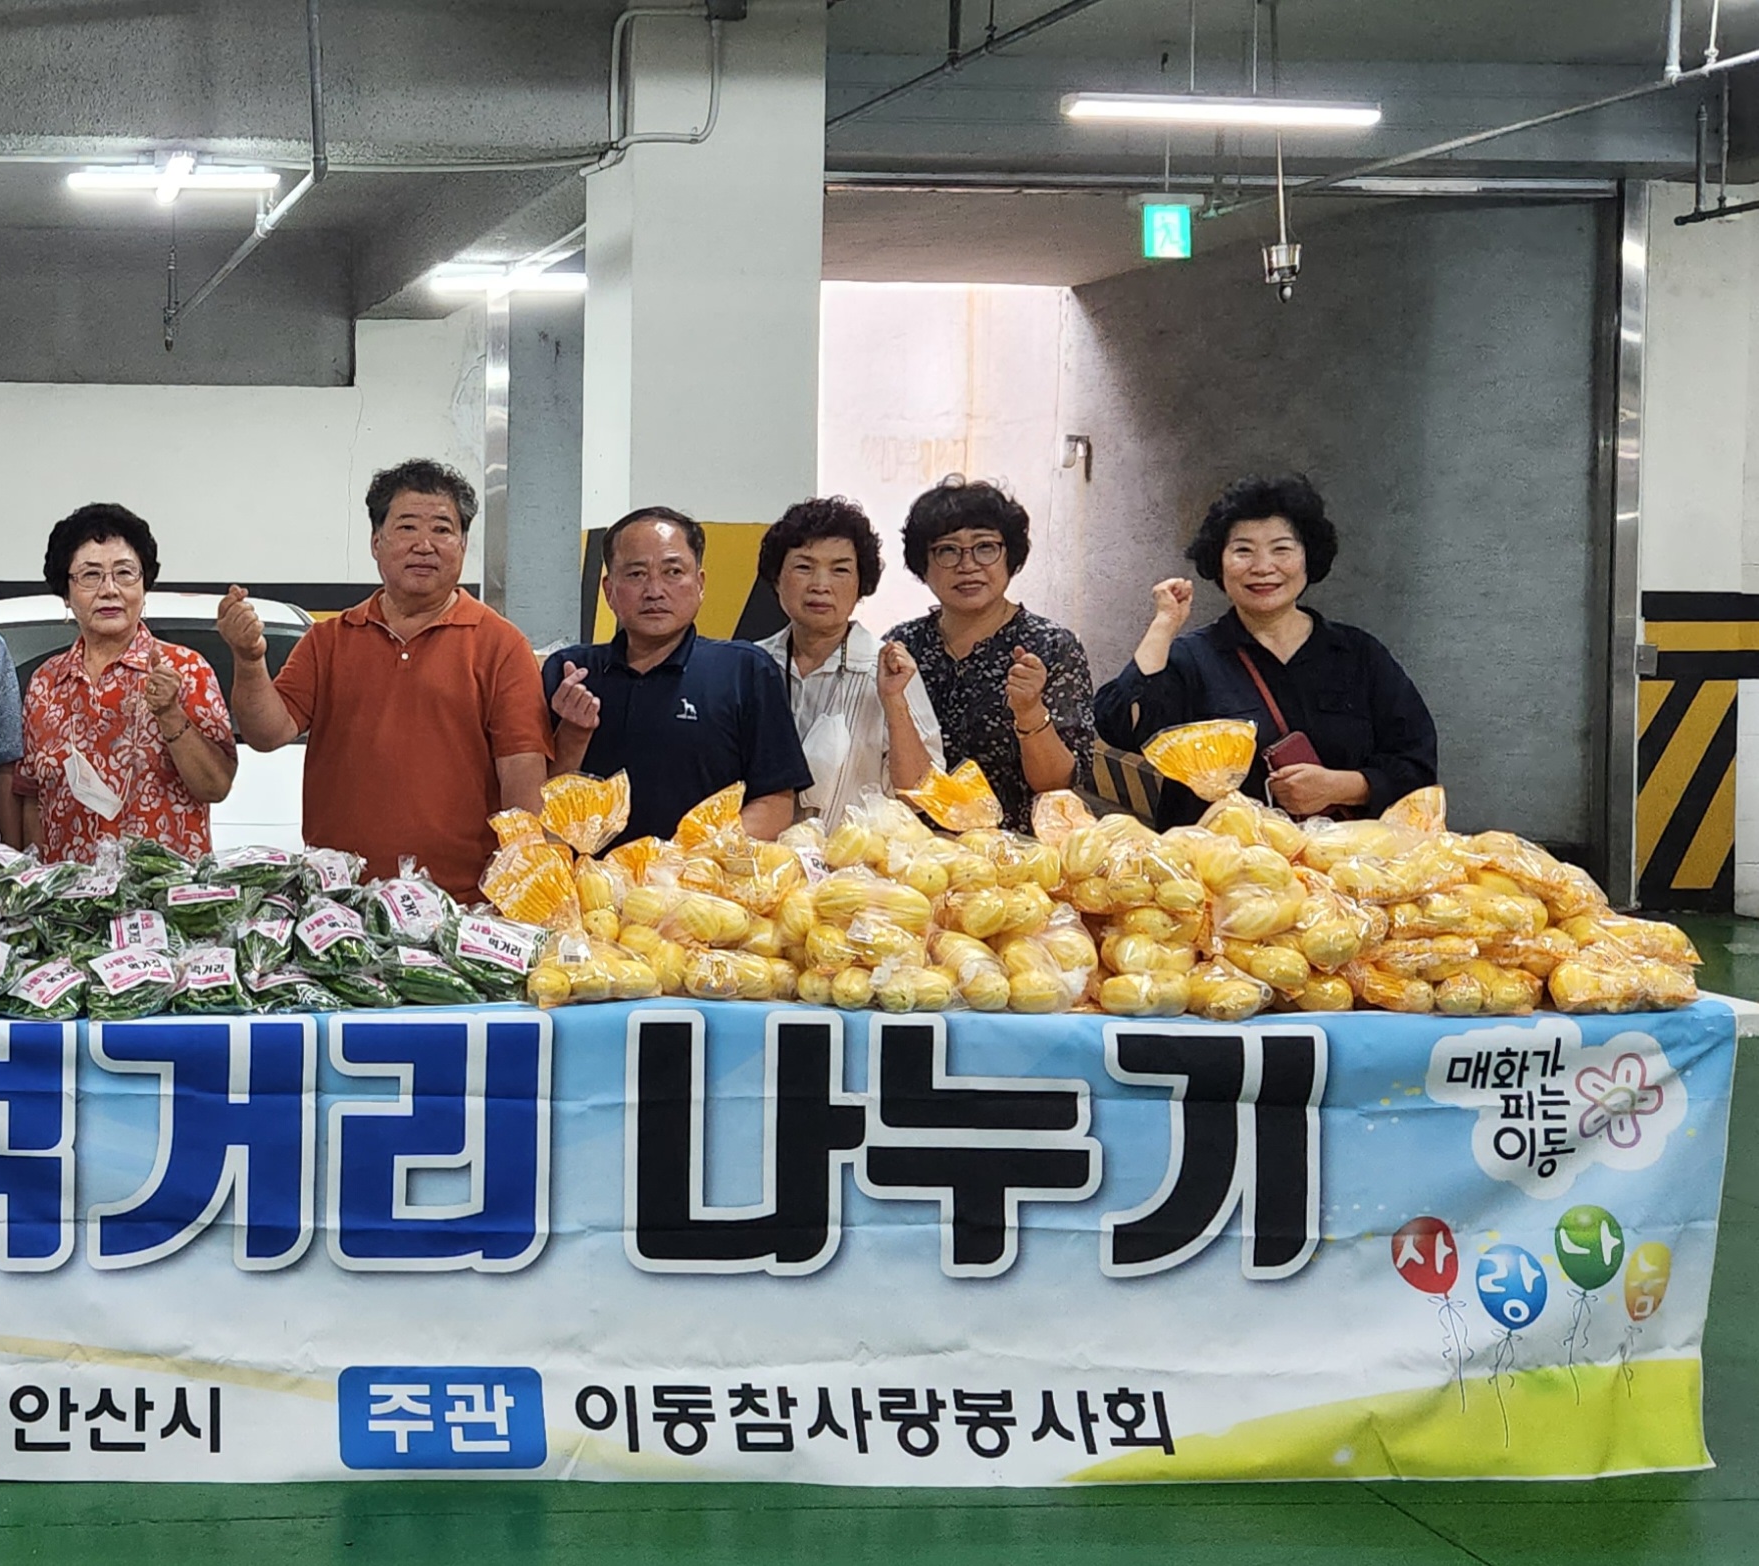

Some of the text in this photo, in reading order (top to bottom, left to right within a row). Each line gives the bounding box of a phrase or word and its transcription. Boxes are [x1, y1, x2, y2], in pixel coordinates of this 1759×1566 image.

[488, 937, 522, 958] 먹거리
[1446, 1037, 1566, 1089] 매화가
[1499, 1083, 1571, 1121] 피는
[636, 1021, 1316, 1268] 나누기
[1493, 1127, 1576, 1179] 이동
[9, 1385, 221, 1454] 안산시
[367, 1381, 516, 1456] 주관
[574, 1383, 1177, 1458] 이동참사랑봉사회
